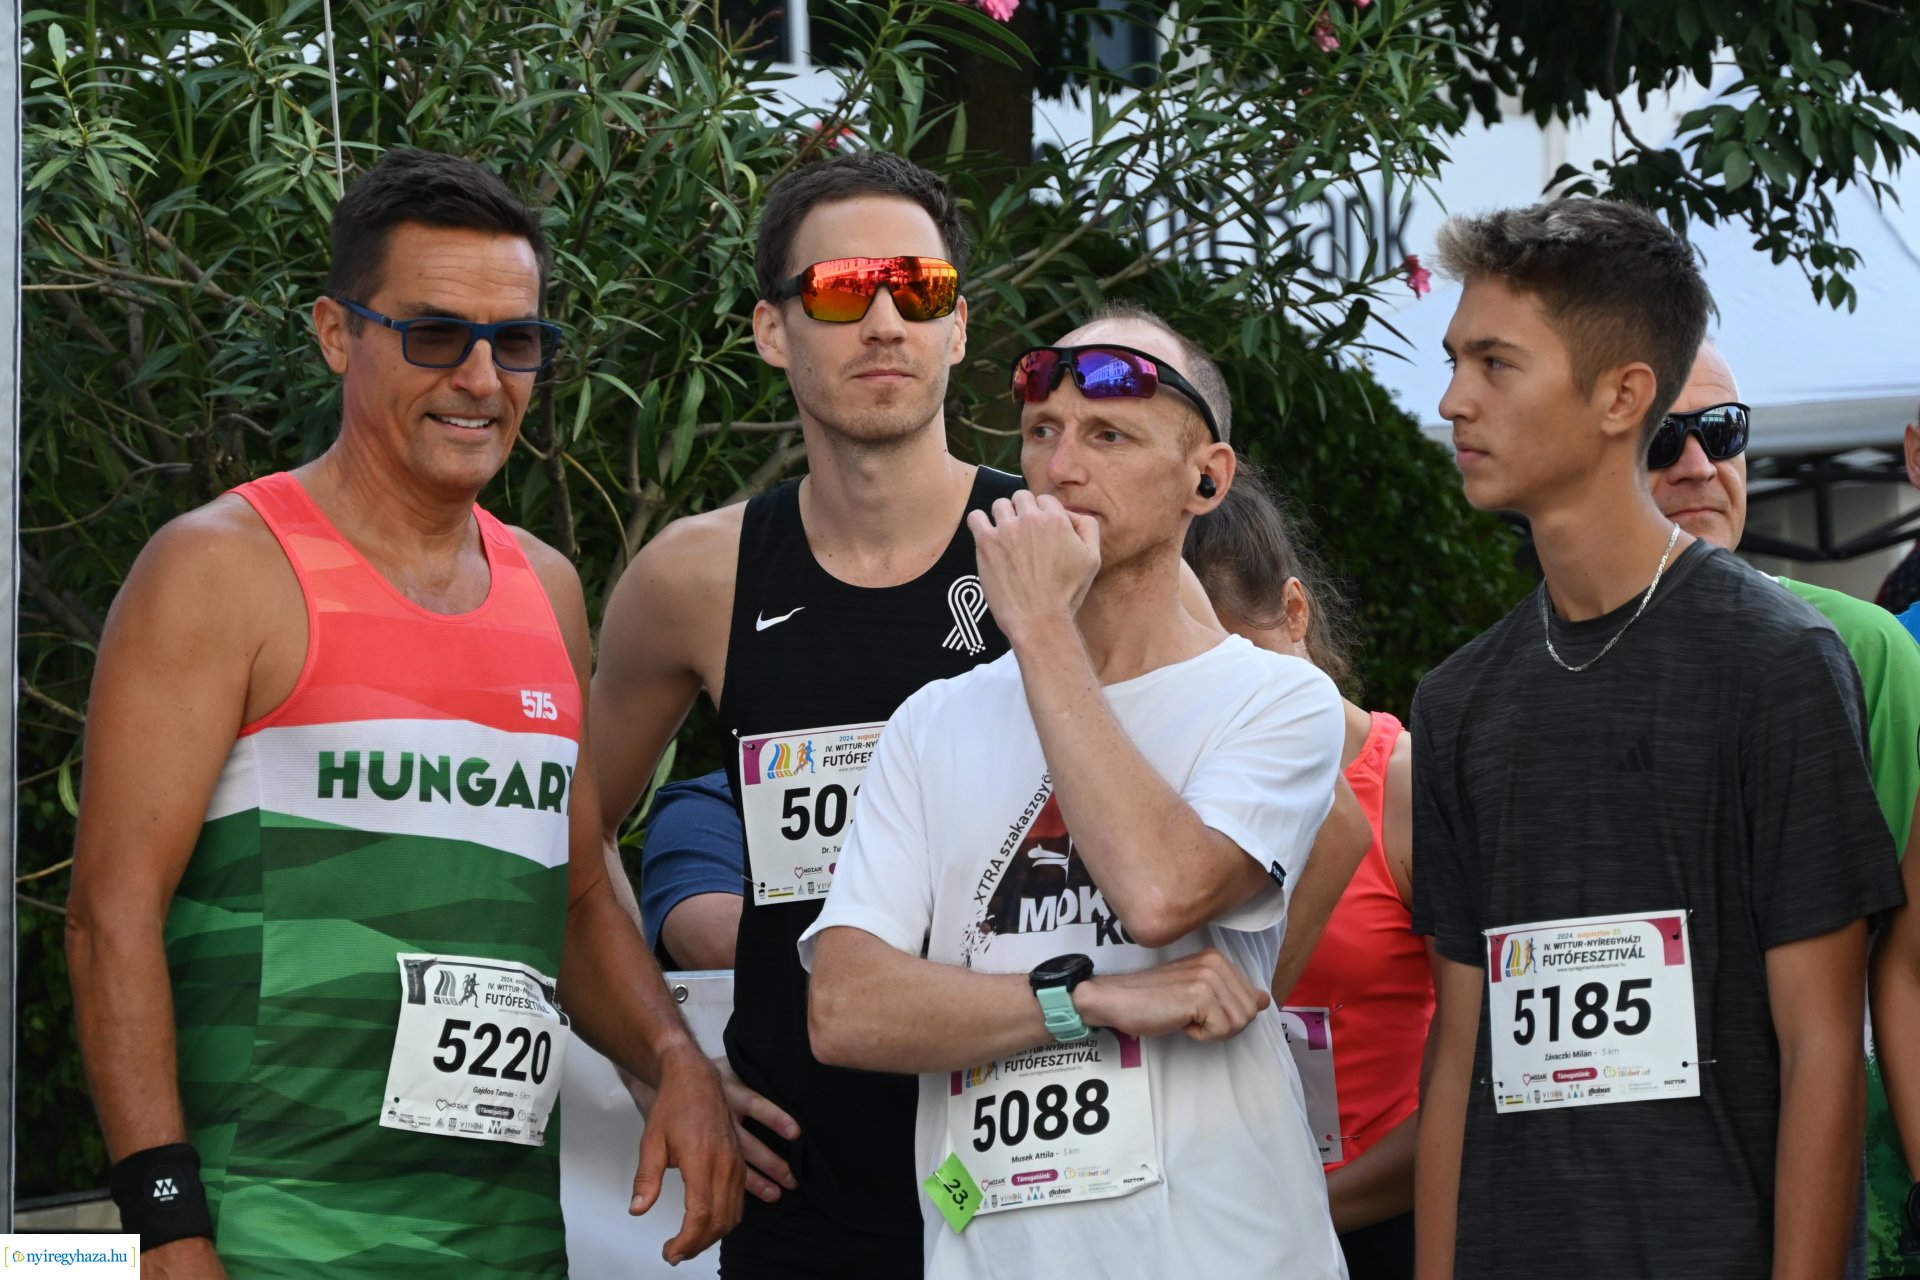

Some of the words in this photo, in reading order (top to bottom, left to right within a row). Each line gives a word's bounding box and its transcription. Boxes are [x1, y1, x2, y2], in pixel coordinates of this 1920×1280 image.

[520, 689, 558, 721] 575
[1018, 885, 1111, 934] MOK
[1542, 944, 1646, 967] FUTÓFESZTIVÁL
[1544, 943, 1552, 951] IV.
[1553, 935, 1641, 950] WITTUR-NYÍREGYHÁZI
[1513, 977, 1653, 1046] 5185
[433, 1018, 552, 1085] 5220
[1004, 1048, 1102, 1073] FUTÓFESZTIVÁL
[1544, 1052, 1571, 1061] Závaczki
[1572, 1050, 1592, 1059] Milán
[473, 1086, 495, 1096] Gajdos
[972, 1078, 1110, 1153] 5088
[1011, 1154, 1033, 1164] Musek
[1034, 1151, 1054, 1160] Attila
[943, 1178, 969, 1211] 23.
